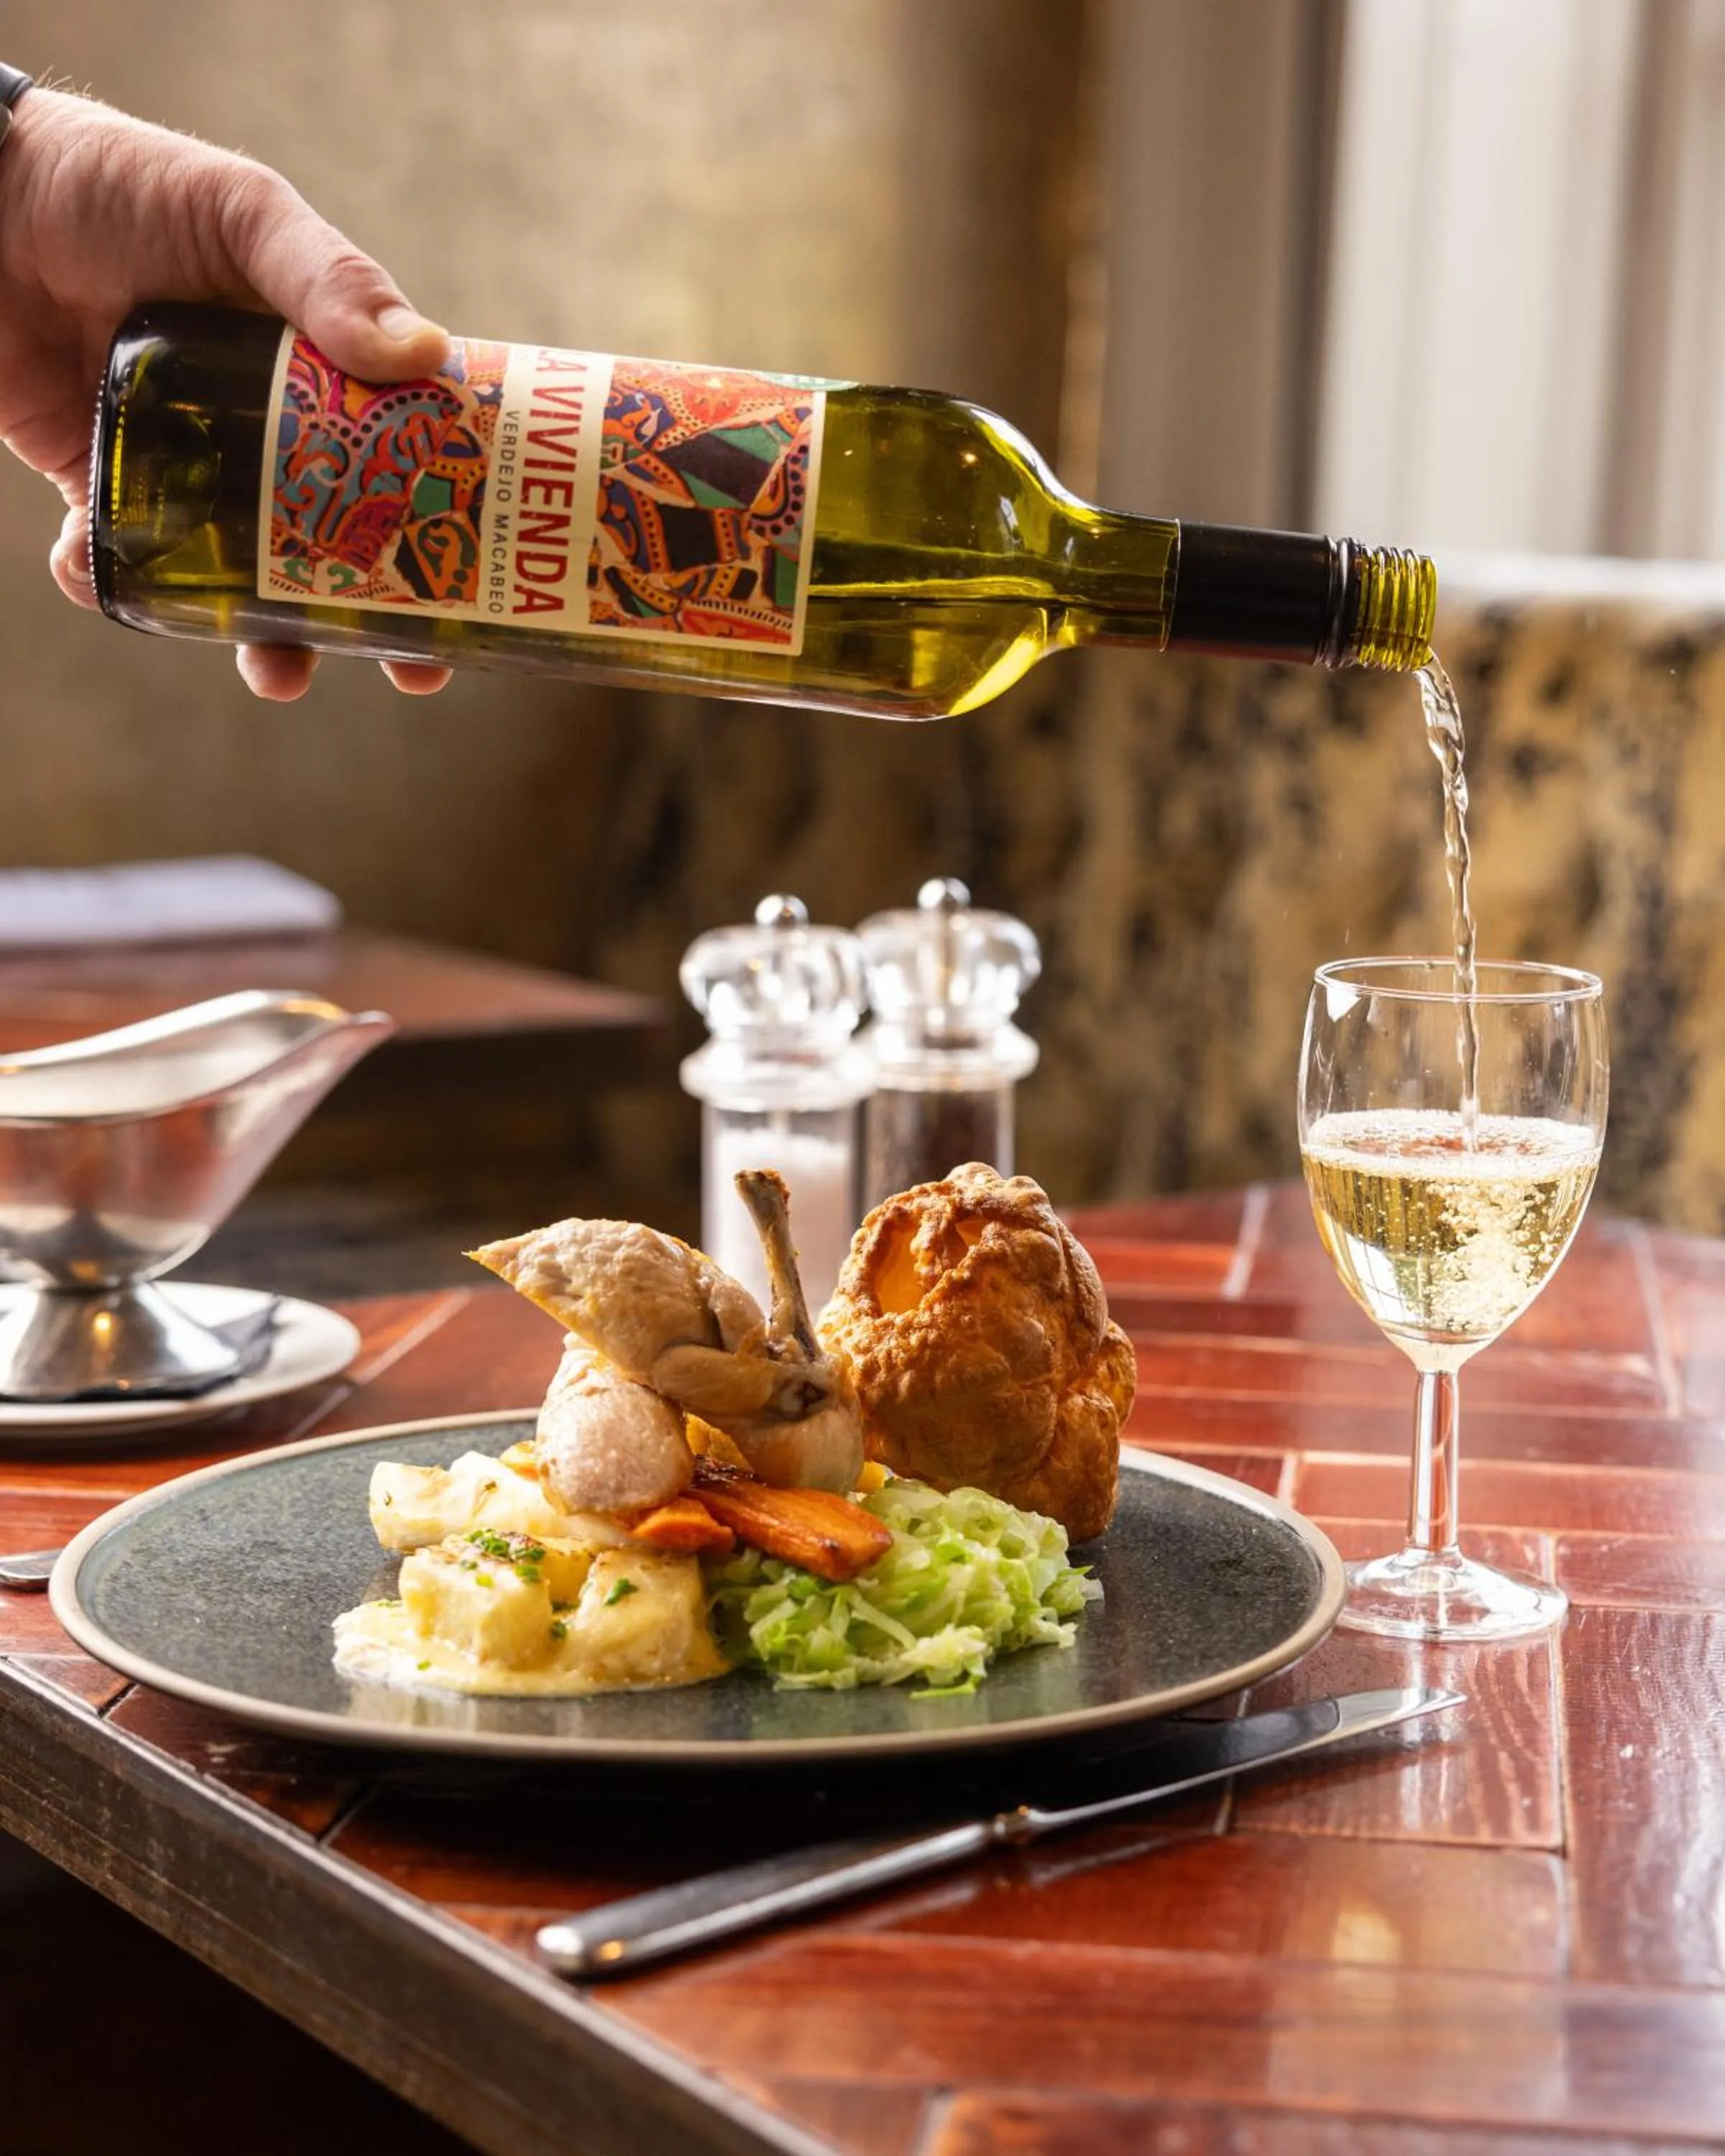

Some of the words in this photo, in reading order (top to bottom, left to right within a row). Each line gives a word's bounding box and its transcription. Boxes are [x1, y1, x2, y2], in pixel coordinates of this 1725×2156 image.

[496, 410, 520, 502] VERDEJO
[512, 386, 585, 614] VIVIENDA
[489, 515, 510, 614] MACABEO
